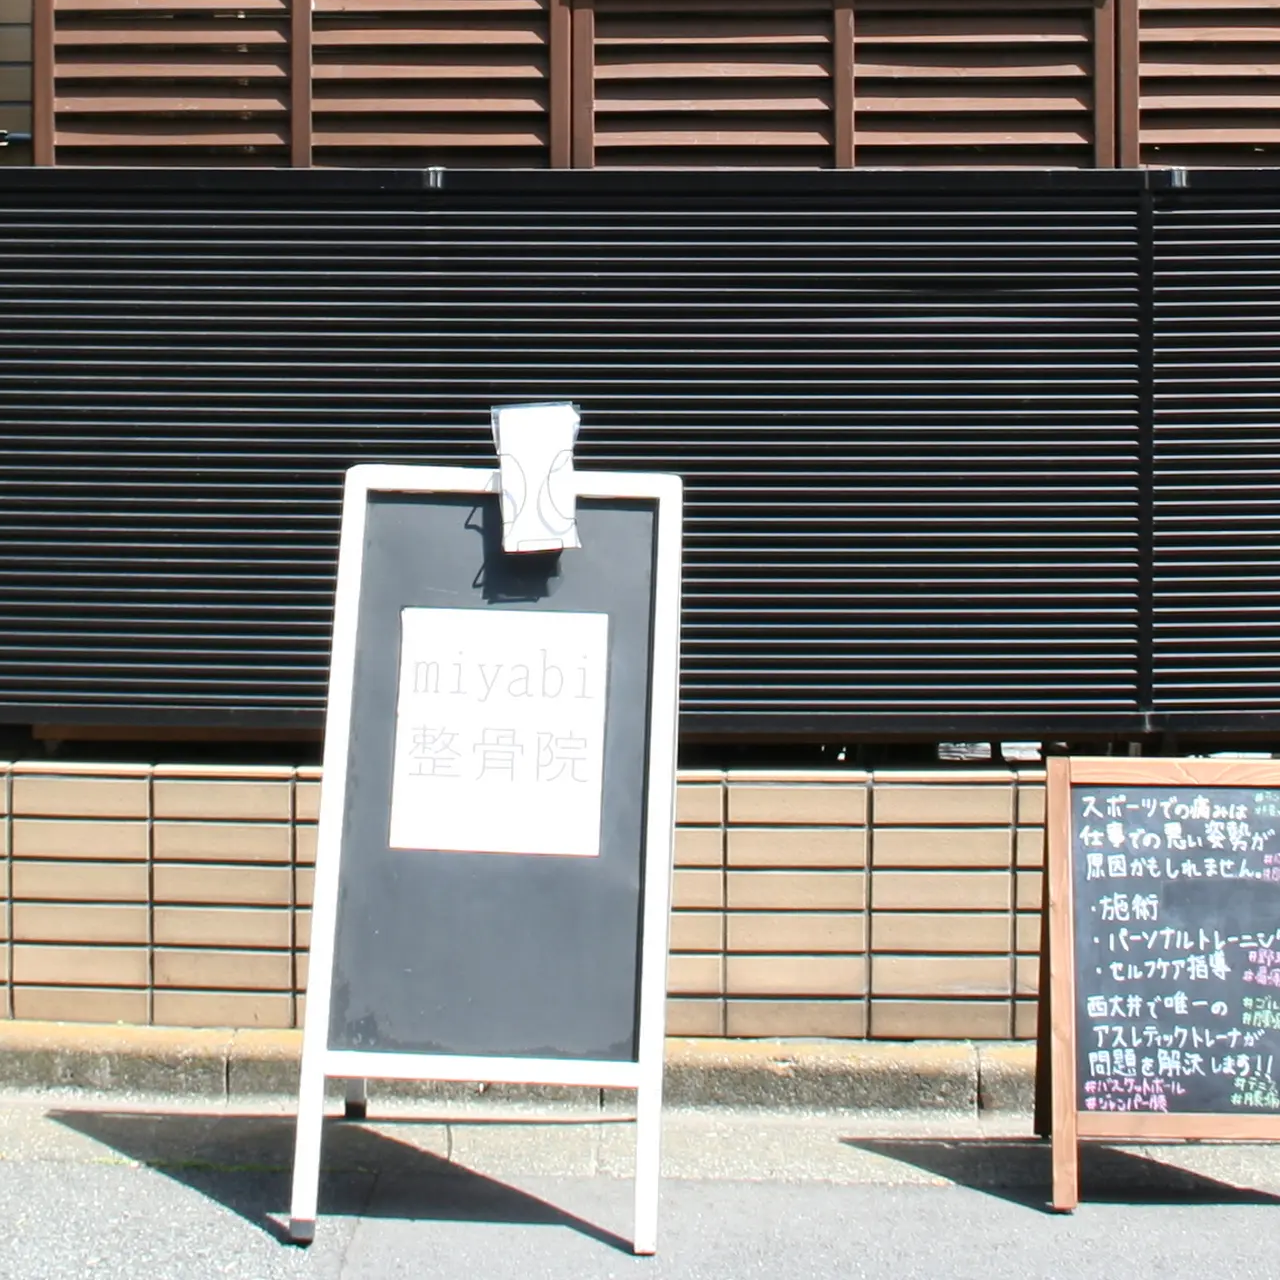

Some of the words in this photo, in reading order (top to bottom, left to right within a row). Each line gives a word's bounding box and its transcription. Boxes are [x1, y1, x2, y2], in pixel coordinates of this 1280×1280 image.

[412, 649, 595, 702] miyabi
[408, 724, 590, 783] 整骨院
[1081, 794, 1249, 821] スポーツでの痛みは
[1079, 821, 1277, 851] 仕事での悪い姿勢が
[1086, 990, 1229, 1019] 西大井で唯一の
